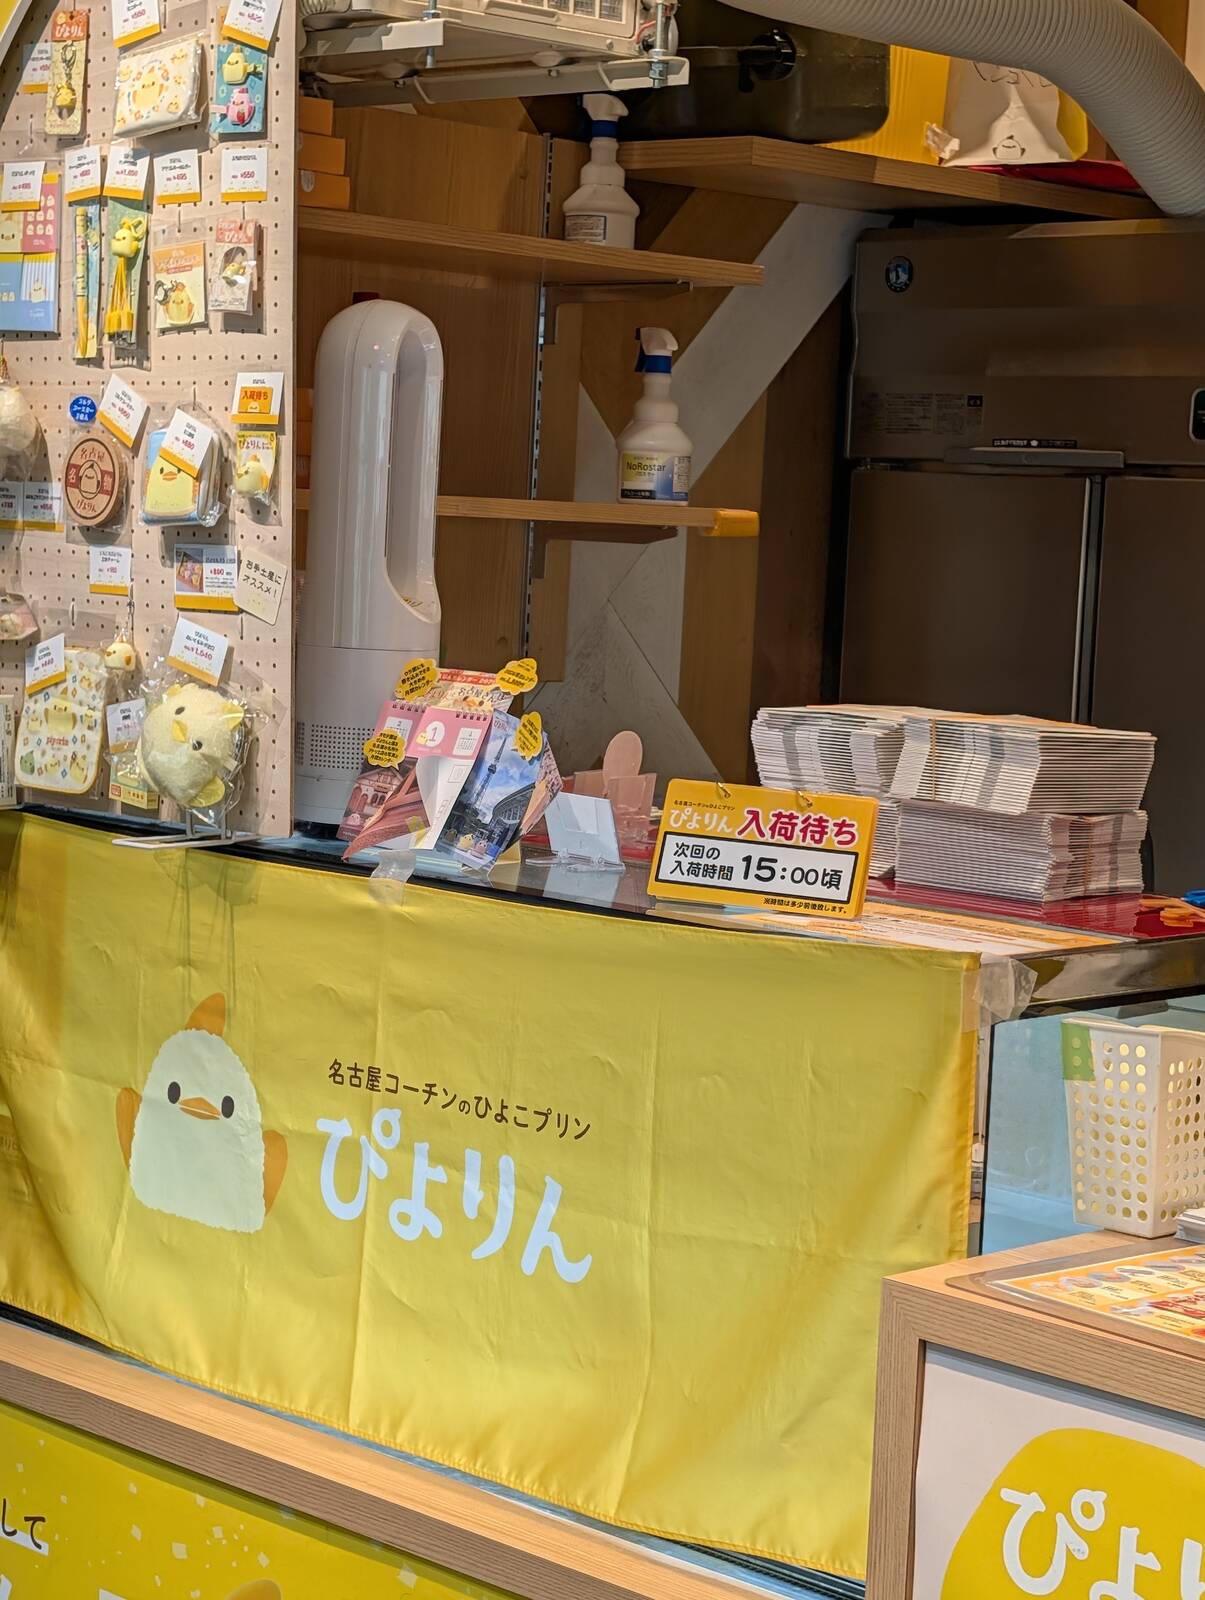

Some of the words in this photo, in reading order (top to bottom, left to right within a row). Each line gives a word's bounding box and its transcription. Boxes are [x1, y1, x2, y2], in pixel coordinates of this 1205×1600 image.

[242, 390, 268, 400] 入荷待ち
[626, 461, 667, 472] NoRostar
[669, 807, 733, 833] ぴよりん
[737, 809, 859, 847] 入荷待ち
[673, 841, 721, 860] 次回の
[669, 860, 734, 882] 入荷時間
[741, 855, 844, 891] 15:00頃
[328, 1058, 591, 1140] 名古屋コーチンのひよこプリン
[315, 1106, 593, 1284] ぴよりん
